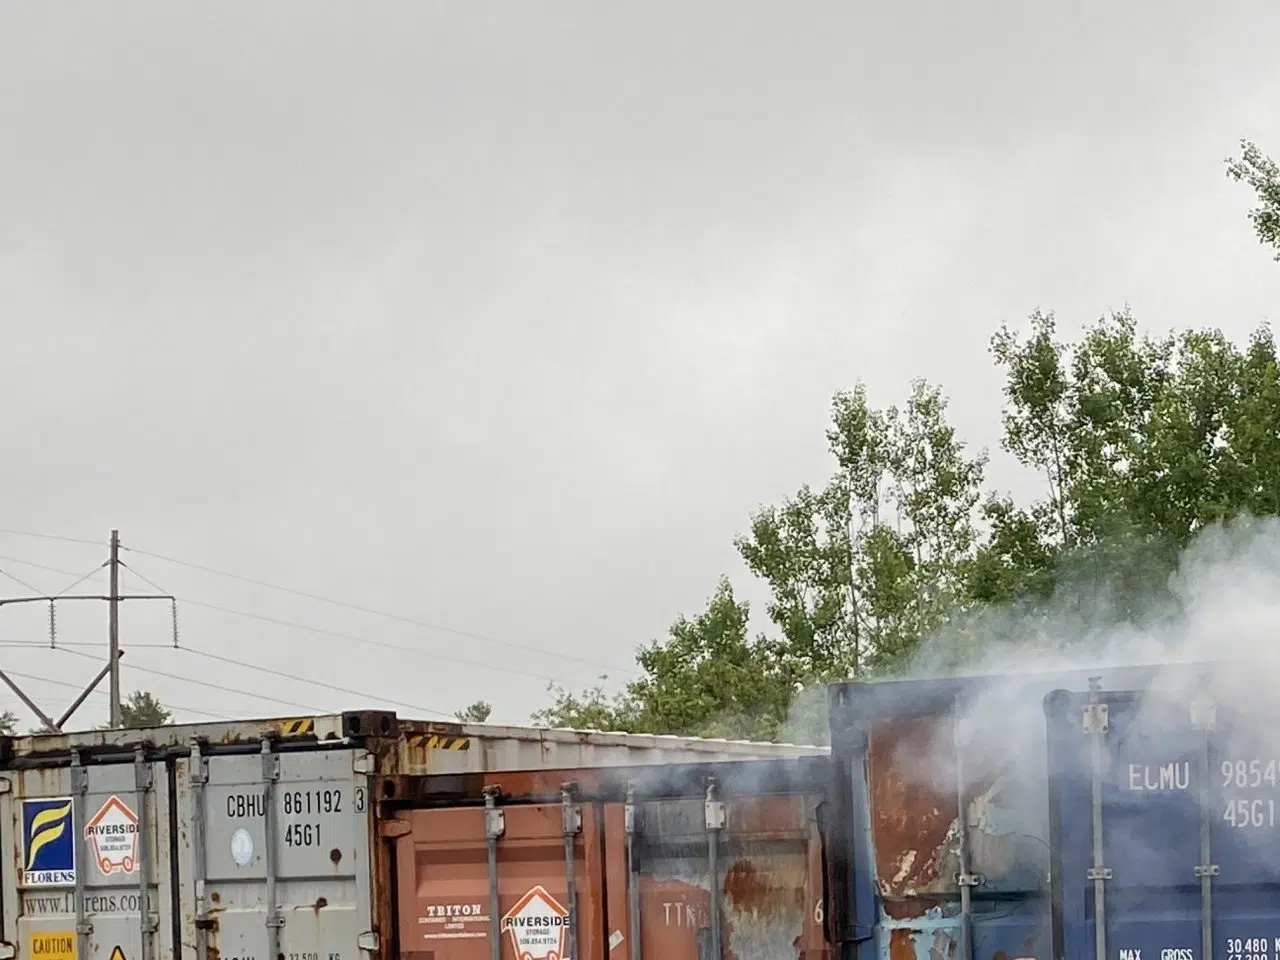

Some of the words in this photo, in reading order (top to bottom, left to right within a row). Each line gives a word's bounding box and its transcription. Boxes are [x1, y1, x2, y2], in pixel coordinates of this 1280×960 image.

[227, 794, 265, 817] CBHU
[284, 790, 342, 814] 861192
[356, 788, 364, 811] 3
[1224, 800, 1275, 828] 45G1
[285, 824, 320, 847] 45G1
[25, 871, 75, 884] FLORENS
[25, 890, 150, 914] www.flrens.co
[427, 904, 481, 916] TRITON
[506, 916, 570, 927] RIVERSIDE
[663, 902, 712, 928] TTN
[33, 938, 73, 954] CAUTION
[1227, 938, 1268, 953] 30.480
